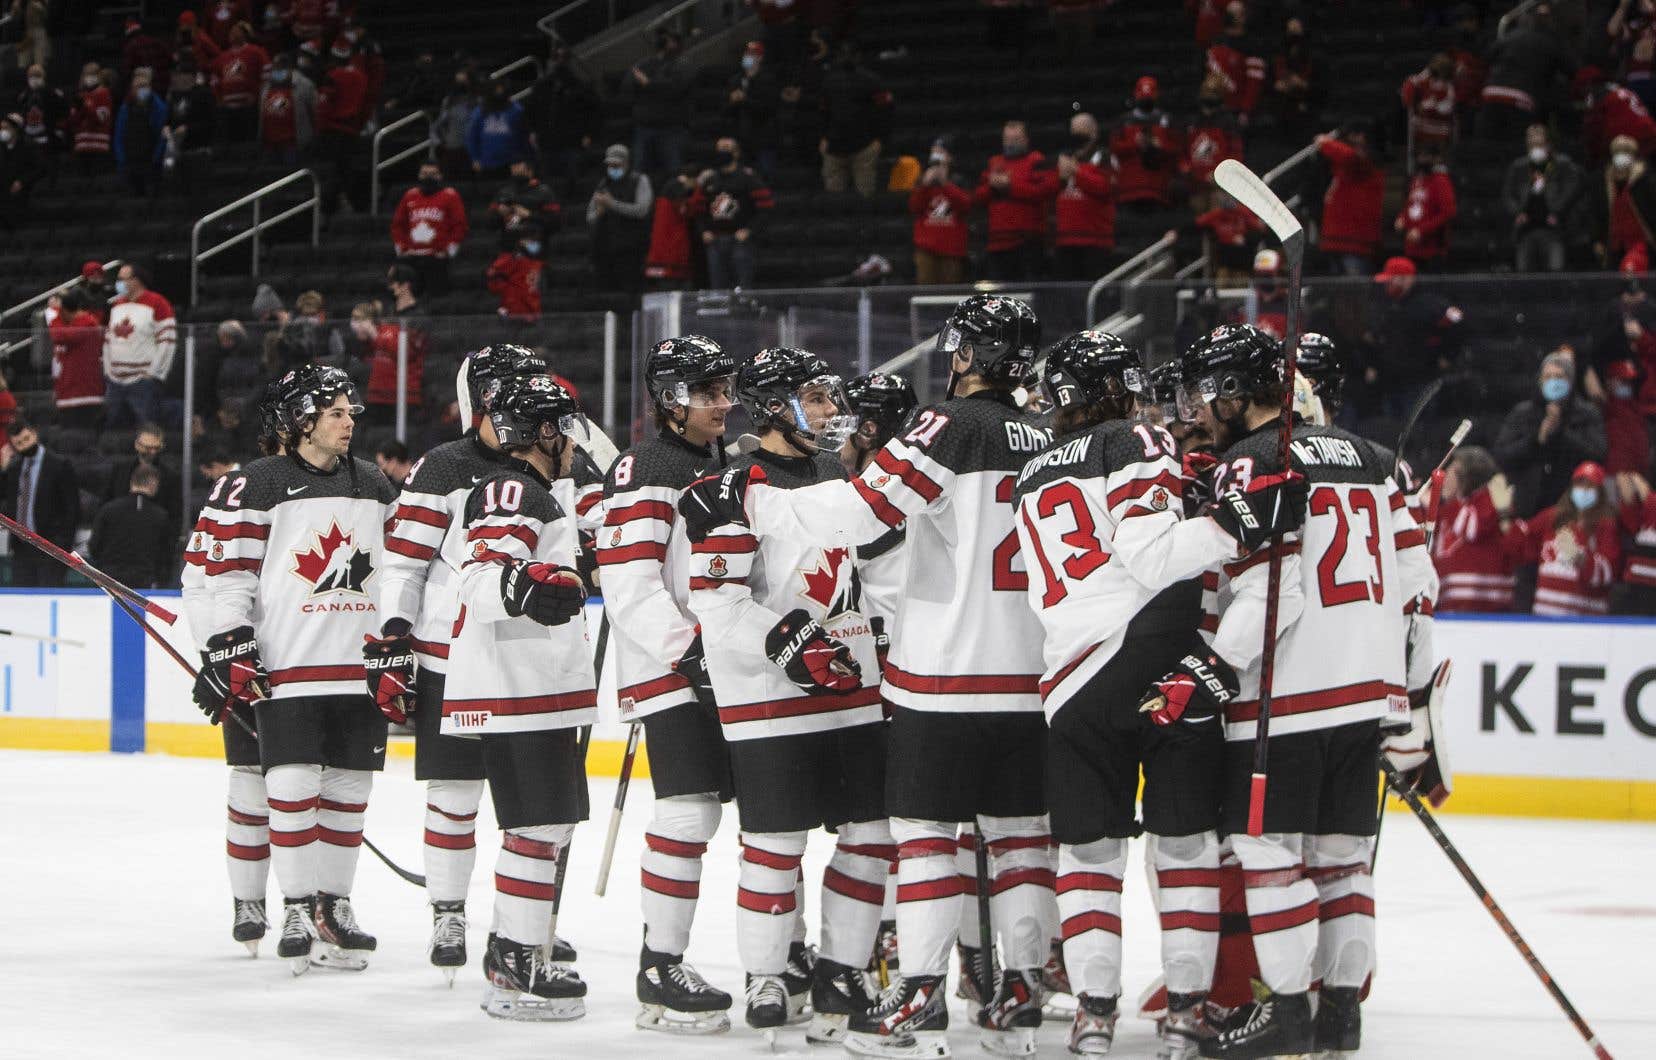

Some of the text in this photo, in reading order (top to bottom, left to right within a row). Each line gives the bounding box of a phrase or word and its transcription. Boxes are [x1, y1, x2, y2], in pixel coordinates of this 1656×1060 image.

[1008, 362, 1024, 377] 21
[1058, 388, 1071, 407] 13
[904, 410, 950, 448] 21
[1133, 423, 1177, 459] 13
[483, 479, 524, 514] 10
[1212, 457, 1254, 502] 23
[1021, 480, 1112, 610] 13
[1308, 486, 1385, 609] 23
[302, 602, 377, 613] CANADA
[775, 617, 822, 670] BAUER
[830, 623, 872, 639] ANADA
[209, 639, 258, 663] BAUER
[364, 654, 413, 669] BAUER
[1180, 654, 1230, 703] BAUER
[460, 712, 489, 727] IIHF
